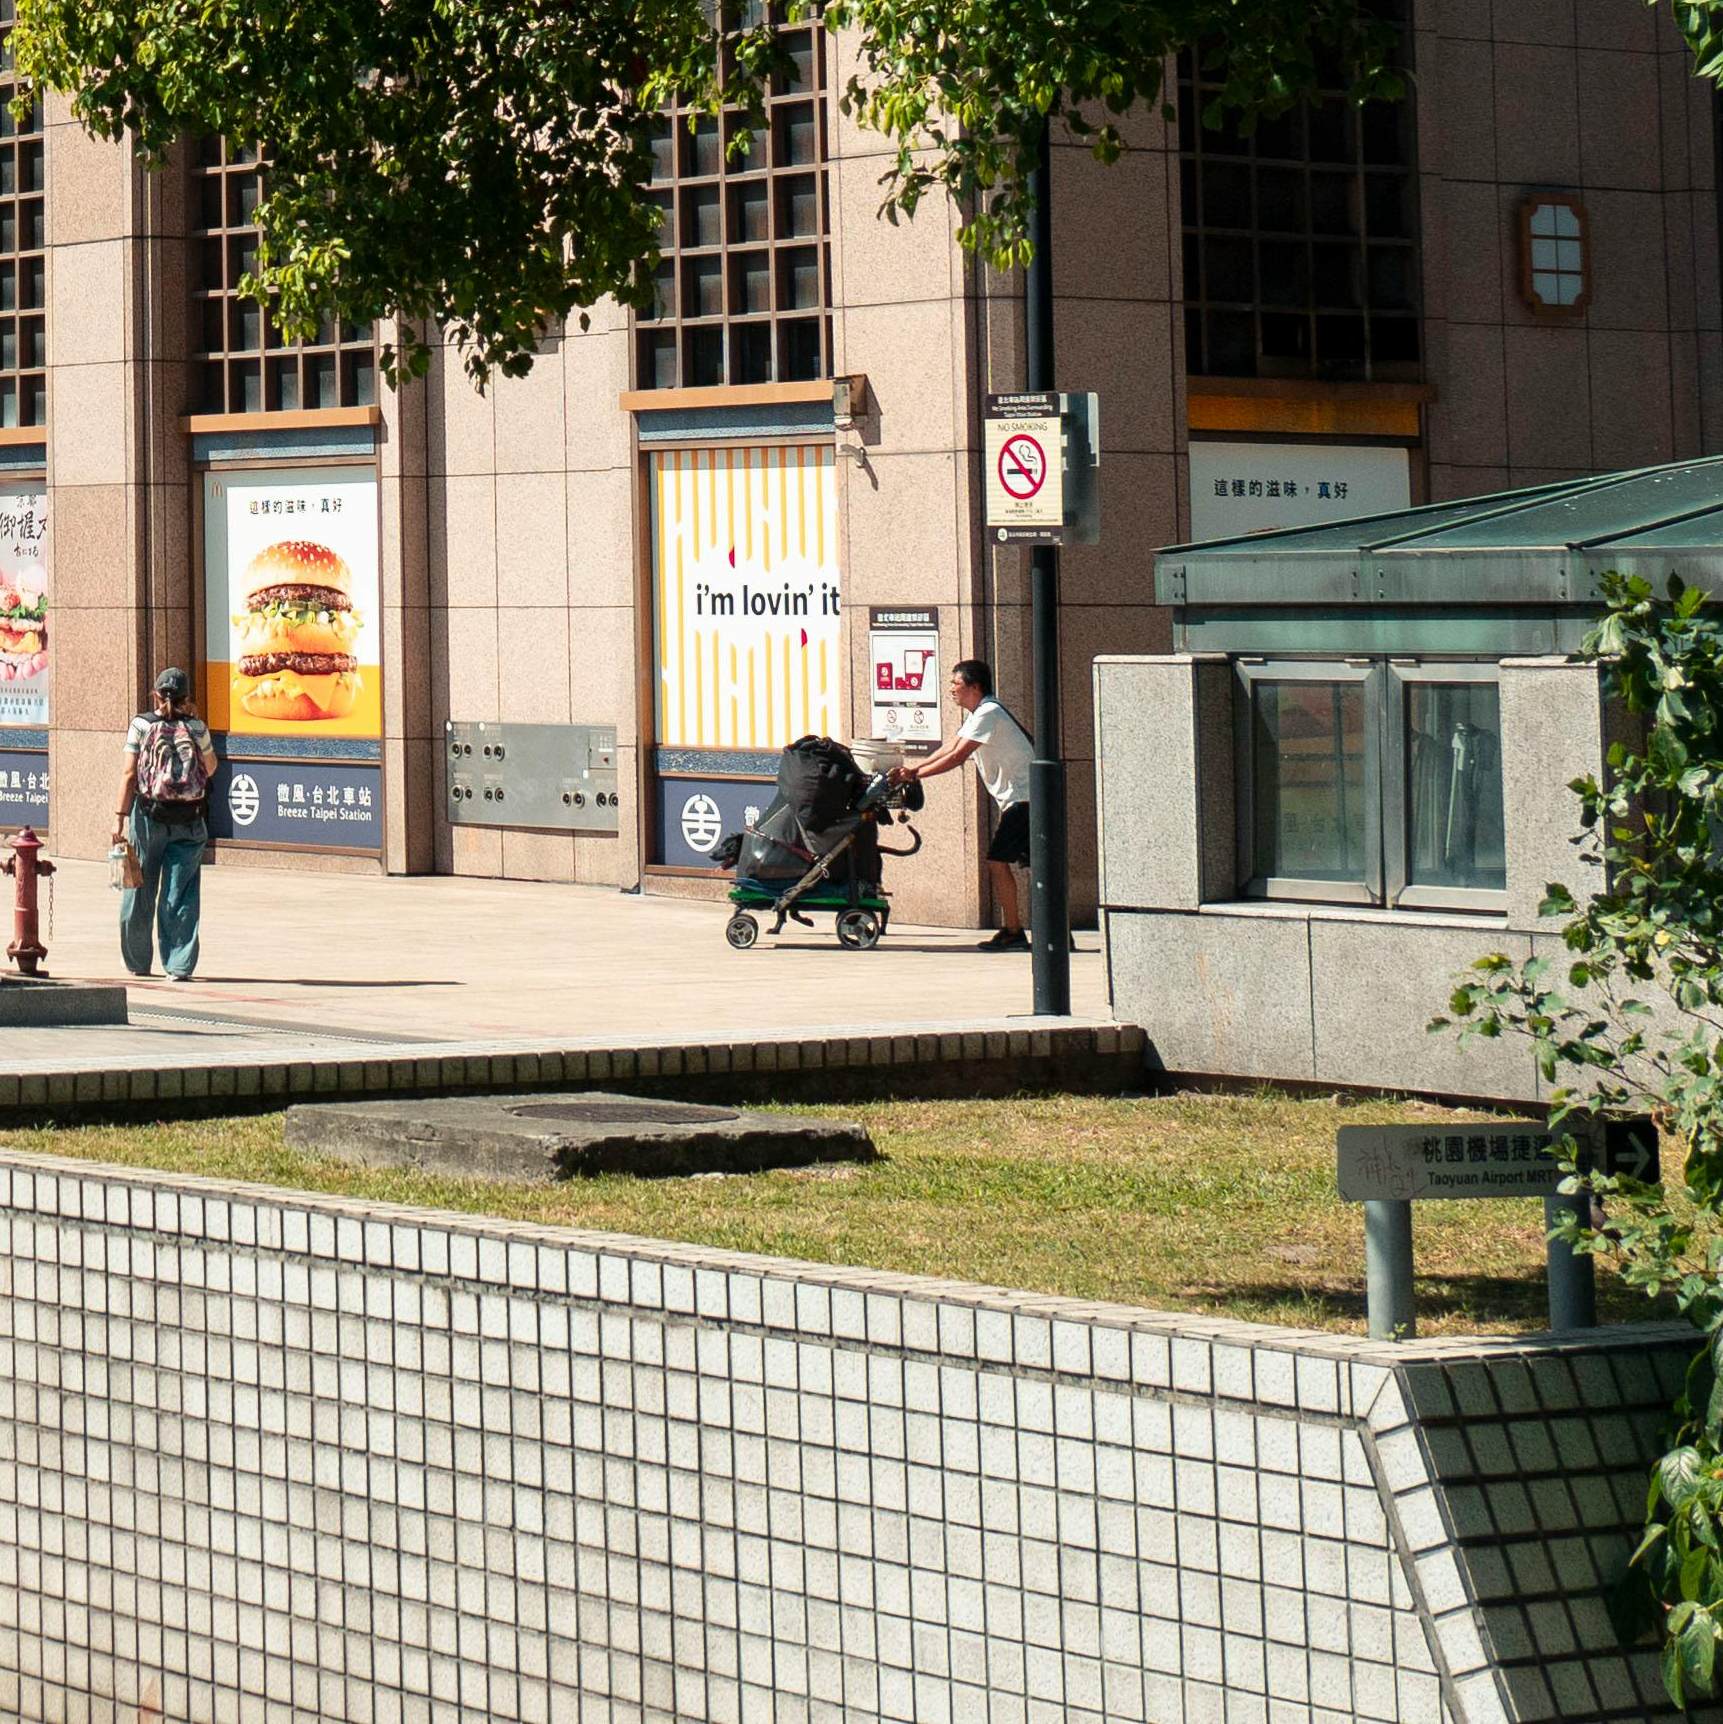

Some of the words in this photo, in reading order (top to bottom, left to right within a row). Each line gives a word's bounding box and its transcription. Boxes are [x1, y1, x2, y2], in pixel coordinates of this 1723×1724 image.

[997, 423, 1010, 431] NO
[1011, 422, 1048, 431] SMOKING
[696, 583, 734, 615] i'm
[743, 583, 814, 615] lovin'
[822, 582, 840, 615] it
[25, 791, 48, 806] Taipei
[277, 805, 308, 819] Breeze
[310, 806, 338, 822] Taipei
[340, 807, 372, 821] Station
[1423, 1134, 1554, 1163] 桃園機場捷運
[1427, 1171, 1478, 1188] Taoyuan
[1481, 1170, 1524, 1187] Airport
[1527, 1169, 1554, 1183] MRT
